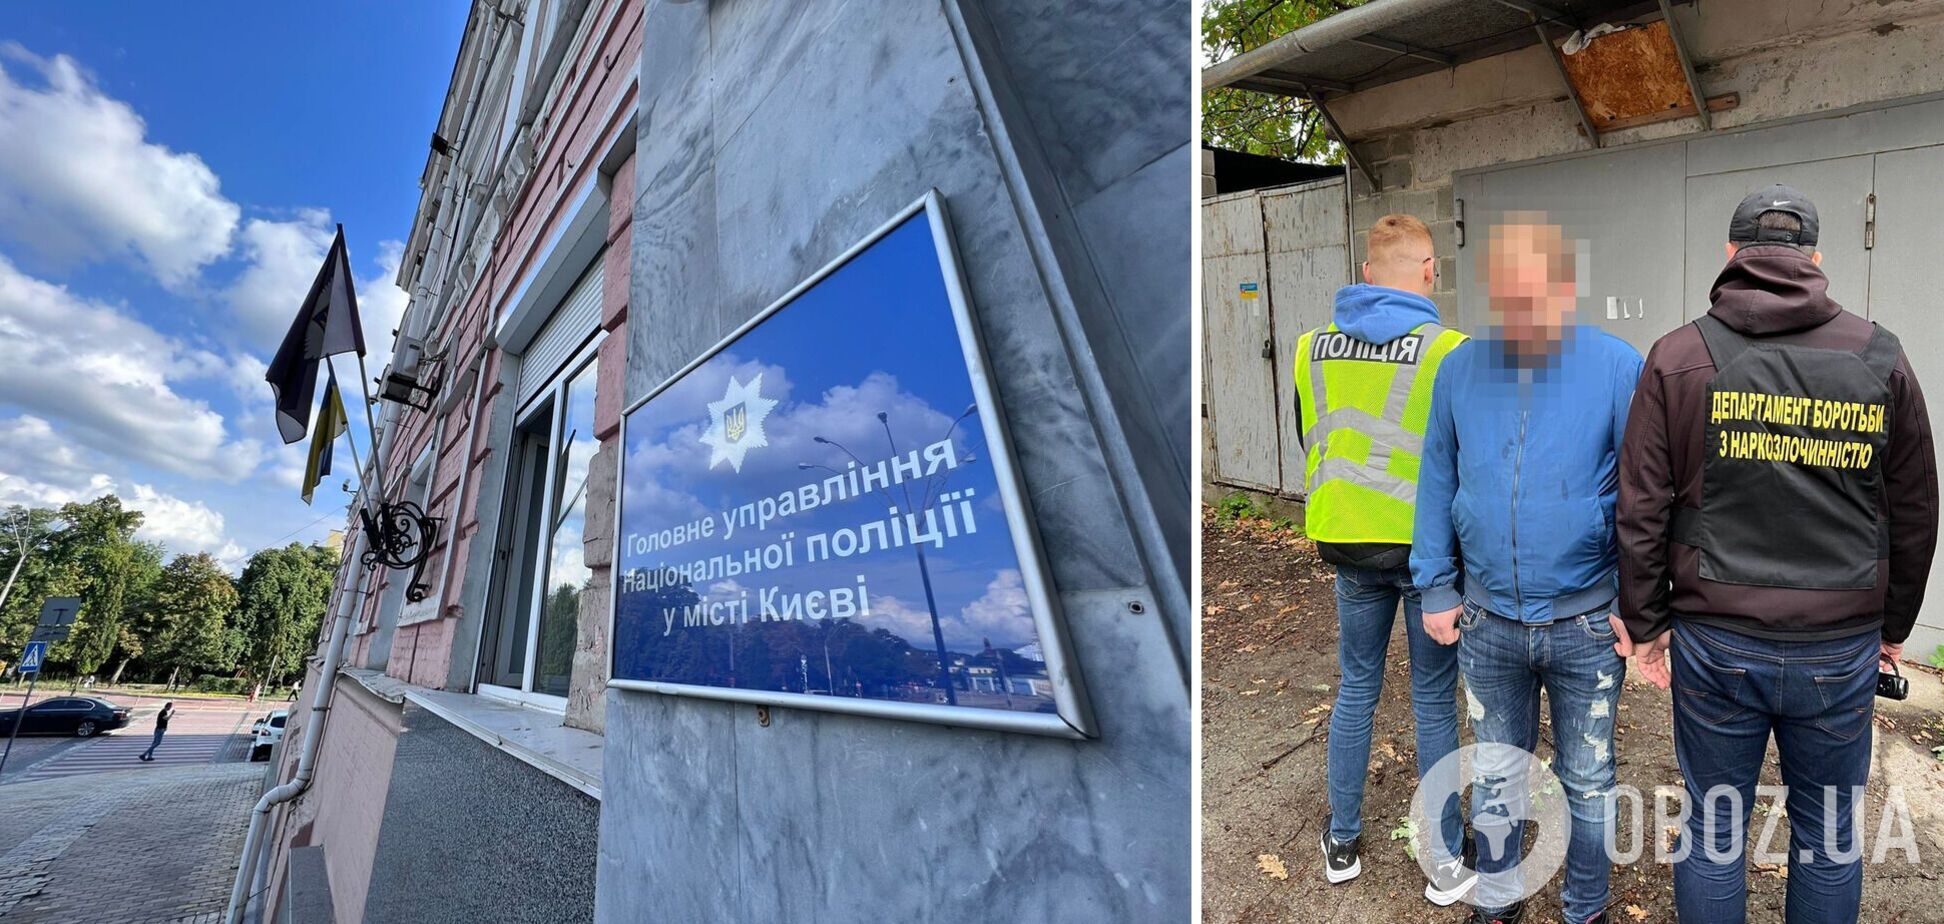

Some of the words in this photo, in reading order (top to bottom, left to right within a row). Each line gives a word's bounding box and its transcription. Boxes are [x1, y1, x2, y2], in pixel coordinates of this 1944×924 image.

[1314, 333, 1419, 362] ПОЛІЦІЯ
[1711, 392, 1811, 426] ДЕПАРТАМЕНТ
[1813, 400, 1885, 433] БОРОТЬБИ
[1719, 431, 1728, 457] З
[1730, 431, 1873, 469] НАРКОЗЛОЧИННІСТЮ
[626, 514, 714, 557] Головне
[723, 438, 958, 540] управління
[623, 532, 794, 594] Національної
[807, 488, 977, 562] поліції
[663, 606, 675, 636] у
[683, 590, 748, 629] місті
[760, 574, 870, 623] Києві
